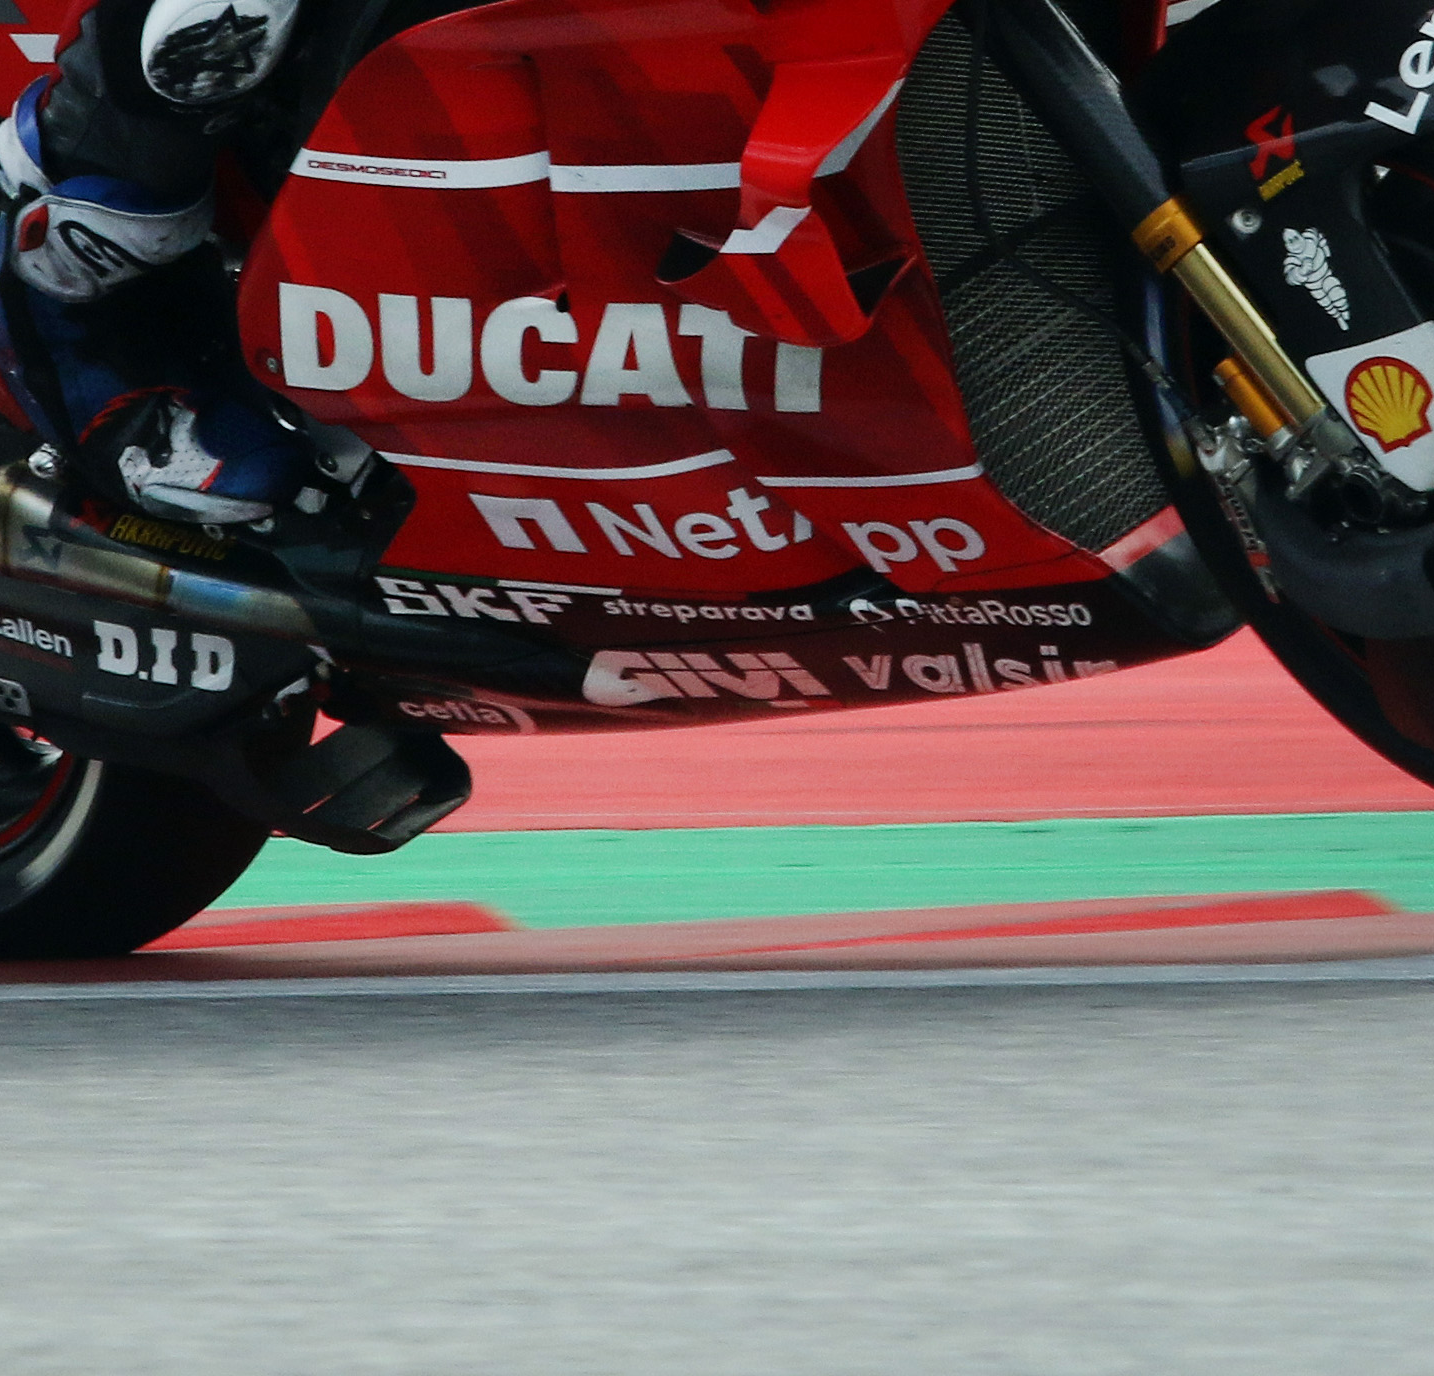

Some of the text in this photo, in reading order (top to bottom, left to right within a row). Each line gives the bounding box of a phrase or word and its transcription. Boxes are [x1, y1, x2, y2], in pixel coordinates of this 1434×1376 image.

[278, 281, 823, 414] DUCATI
[584, 487, 986, 574] Netpp
[373, 575, 573, 625] SKF
[603, 598, 814, 624] streparava
[582, 649, 832, 708] GIVI
